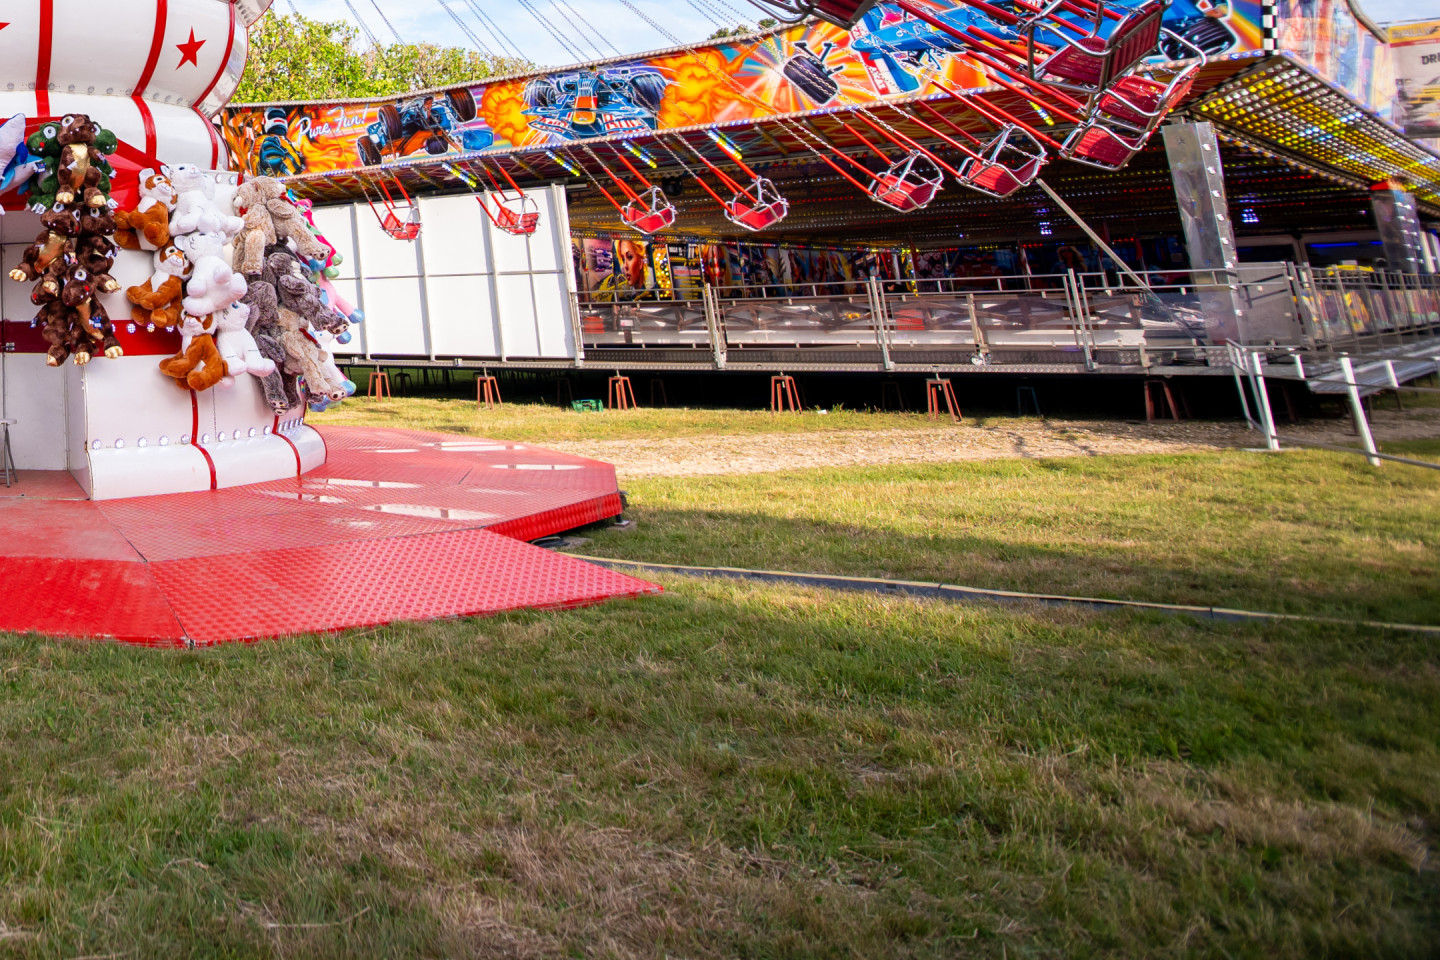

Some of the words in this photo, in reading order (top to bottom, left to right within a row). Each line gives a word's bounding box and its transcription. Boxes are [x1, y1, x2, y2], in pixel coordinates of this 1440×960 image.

[1421, 52, 1440, 65] DR
[295, 116, 331, 145] Pure
[327, 103, 369, 133] Fun!
